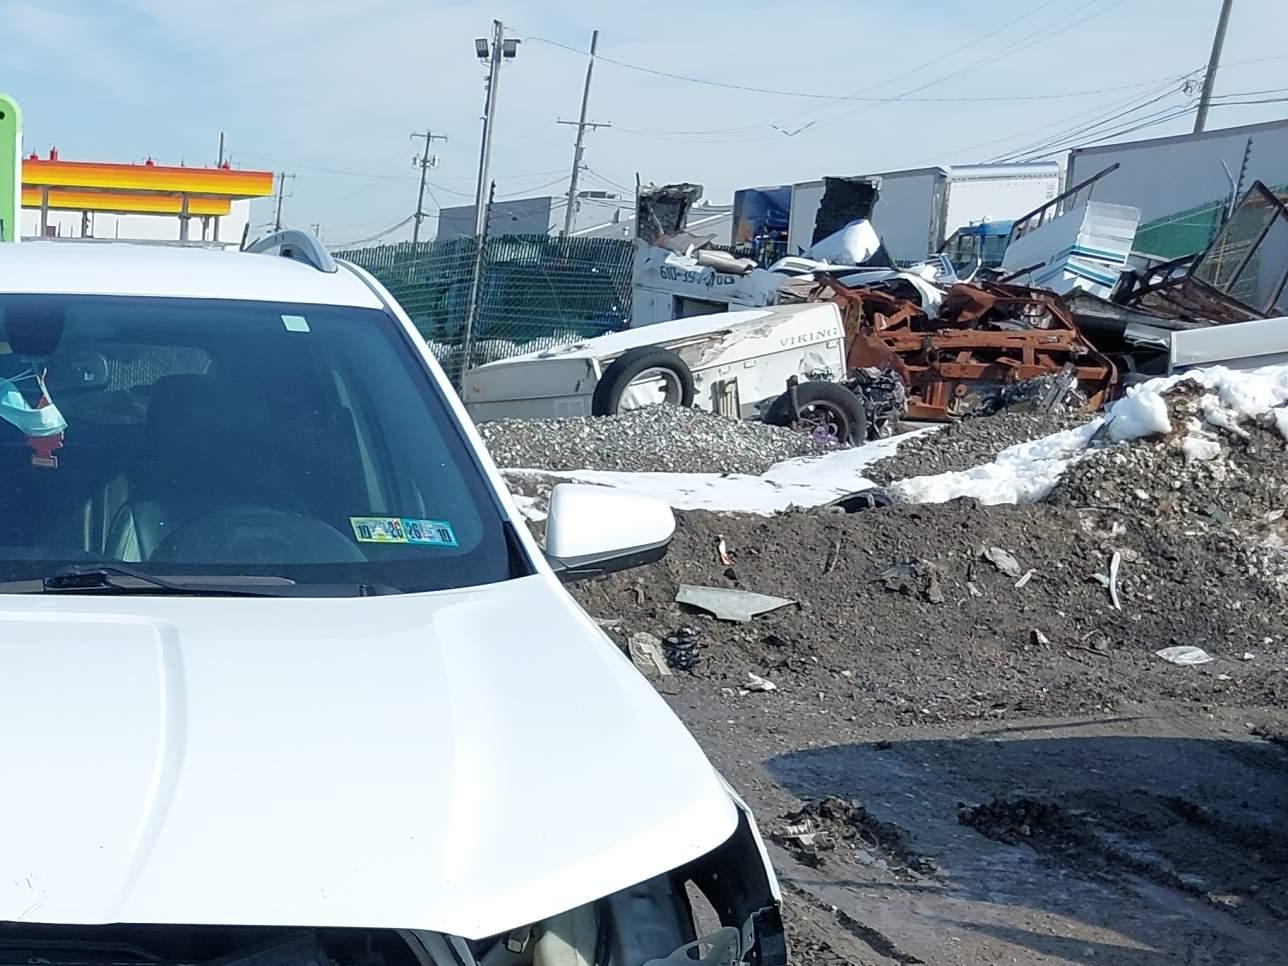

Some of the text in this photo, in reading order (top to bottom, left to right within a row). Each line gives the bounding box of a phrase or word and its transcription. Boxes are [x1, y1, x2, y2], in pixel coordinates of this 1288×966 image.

[780, 327, 837, 346] VIKING
[358, 525, 372, 539] 10
[437, 528, 452, 543] 10
